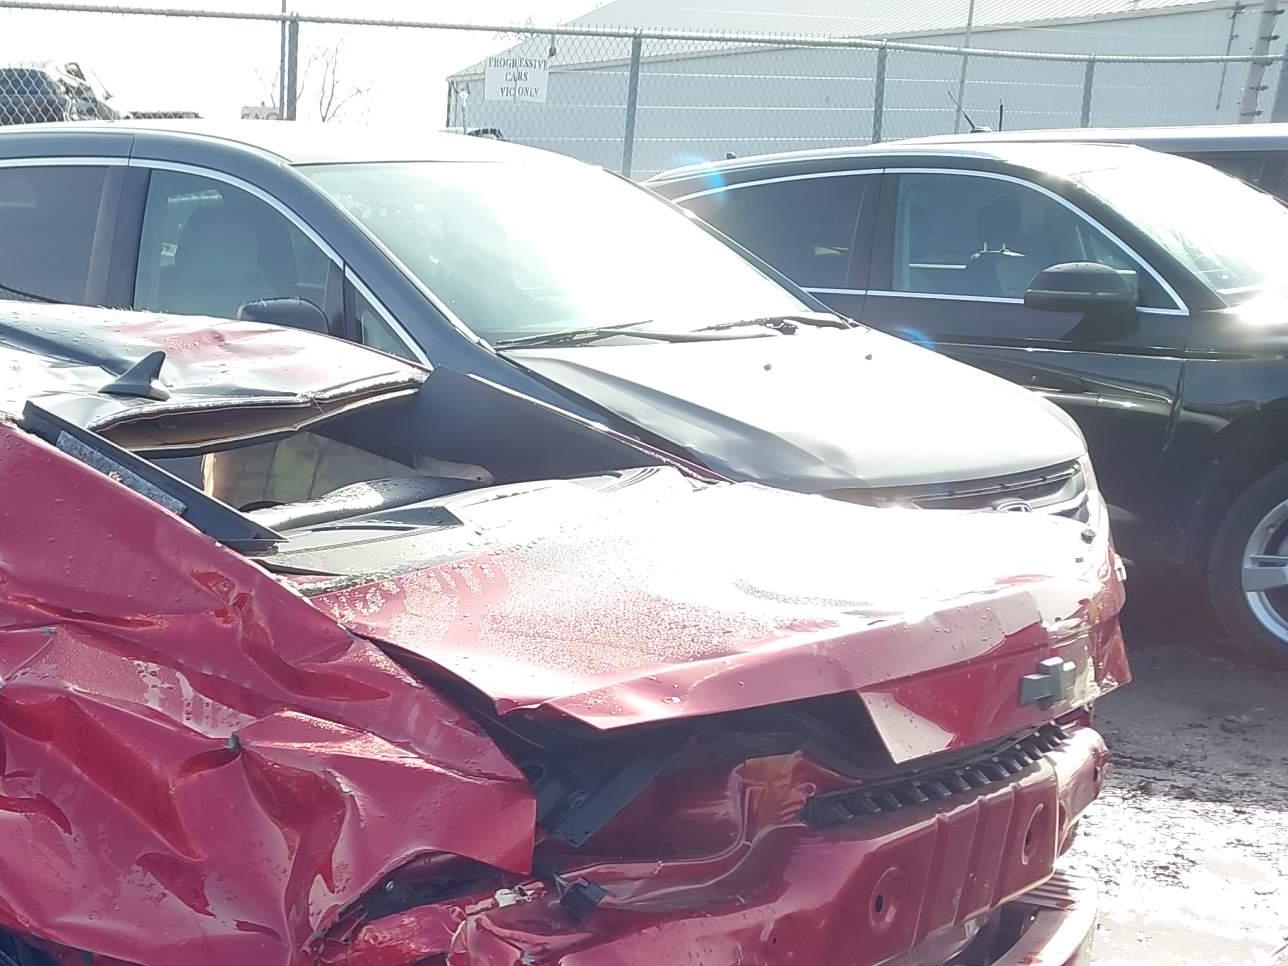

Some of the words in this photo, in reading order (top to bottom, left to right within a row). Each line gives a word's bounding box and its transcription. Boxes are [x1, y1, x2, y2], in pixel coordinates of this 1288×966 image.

[488, 57, 549, 71] PROGRESSIVE
[505, 71, 528, 82] CARS
[517, 86, 540, 97] ONLY
